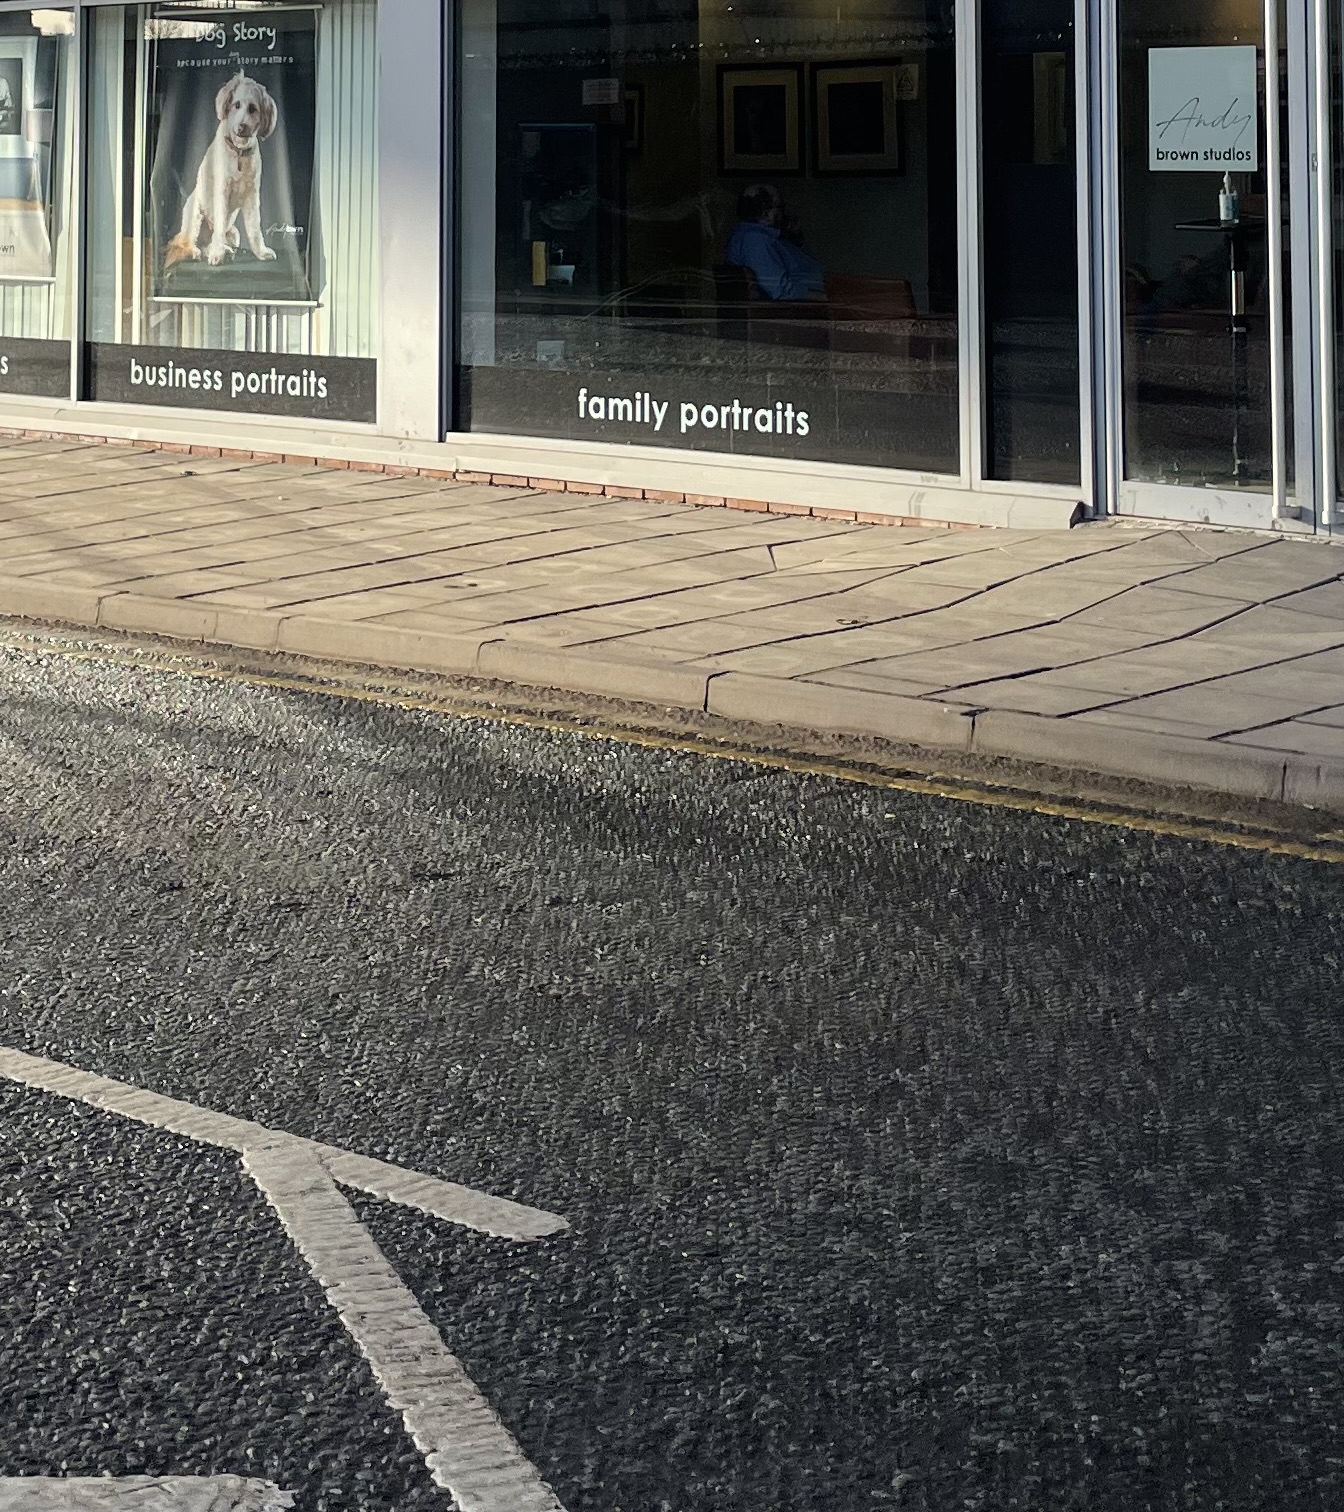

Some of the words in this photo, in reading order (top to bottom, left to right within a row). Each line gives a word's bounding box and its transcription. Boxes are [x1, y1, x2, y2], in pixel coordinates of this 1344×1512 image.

[233, 21, 276, 50] Story
[1156, 96, 1253, 145] Andy
[1156, 148, 1198, 162] brown
[1203, 146, 1253, 162] studios
[130, 359, 223, 392] business
[231, 367, 328, 399] portraits
[578, 388, 668, 431] family
[681, 395, 810, 437] portraits
